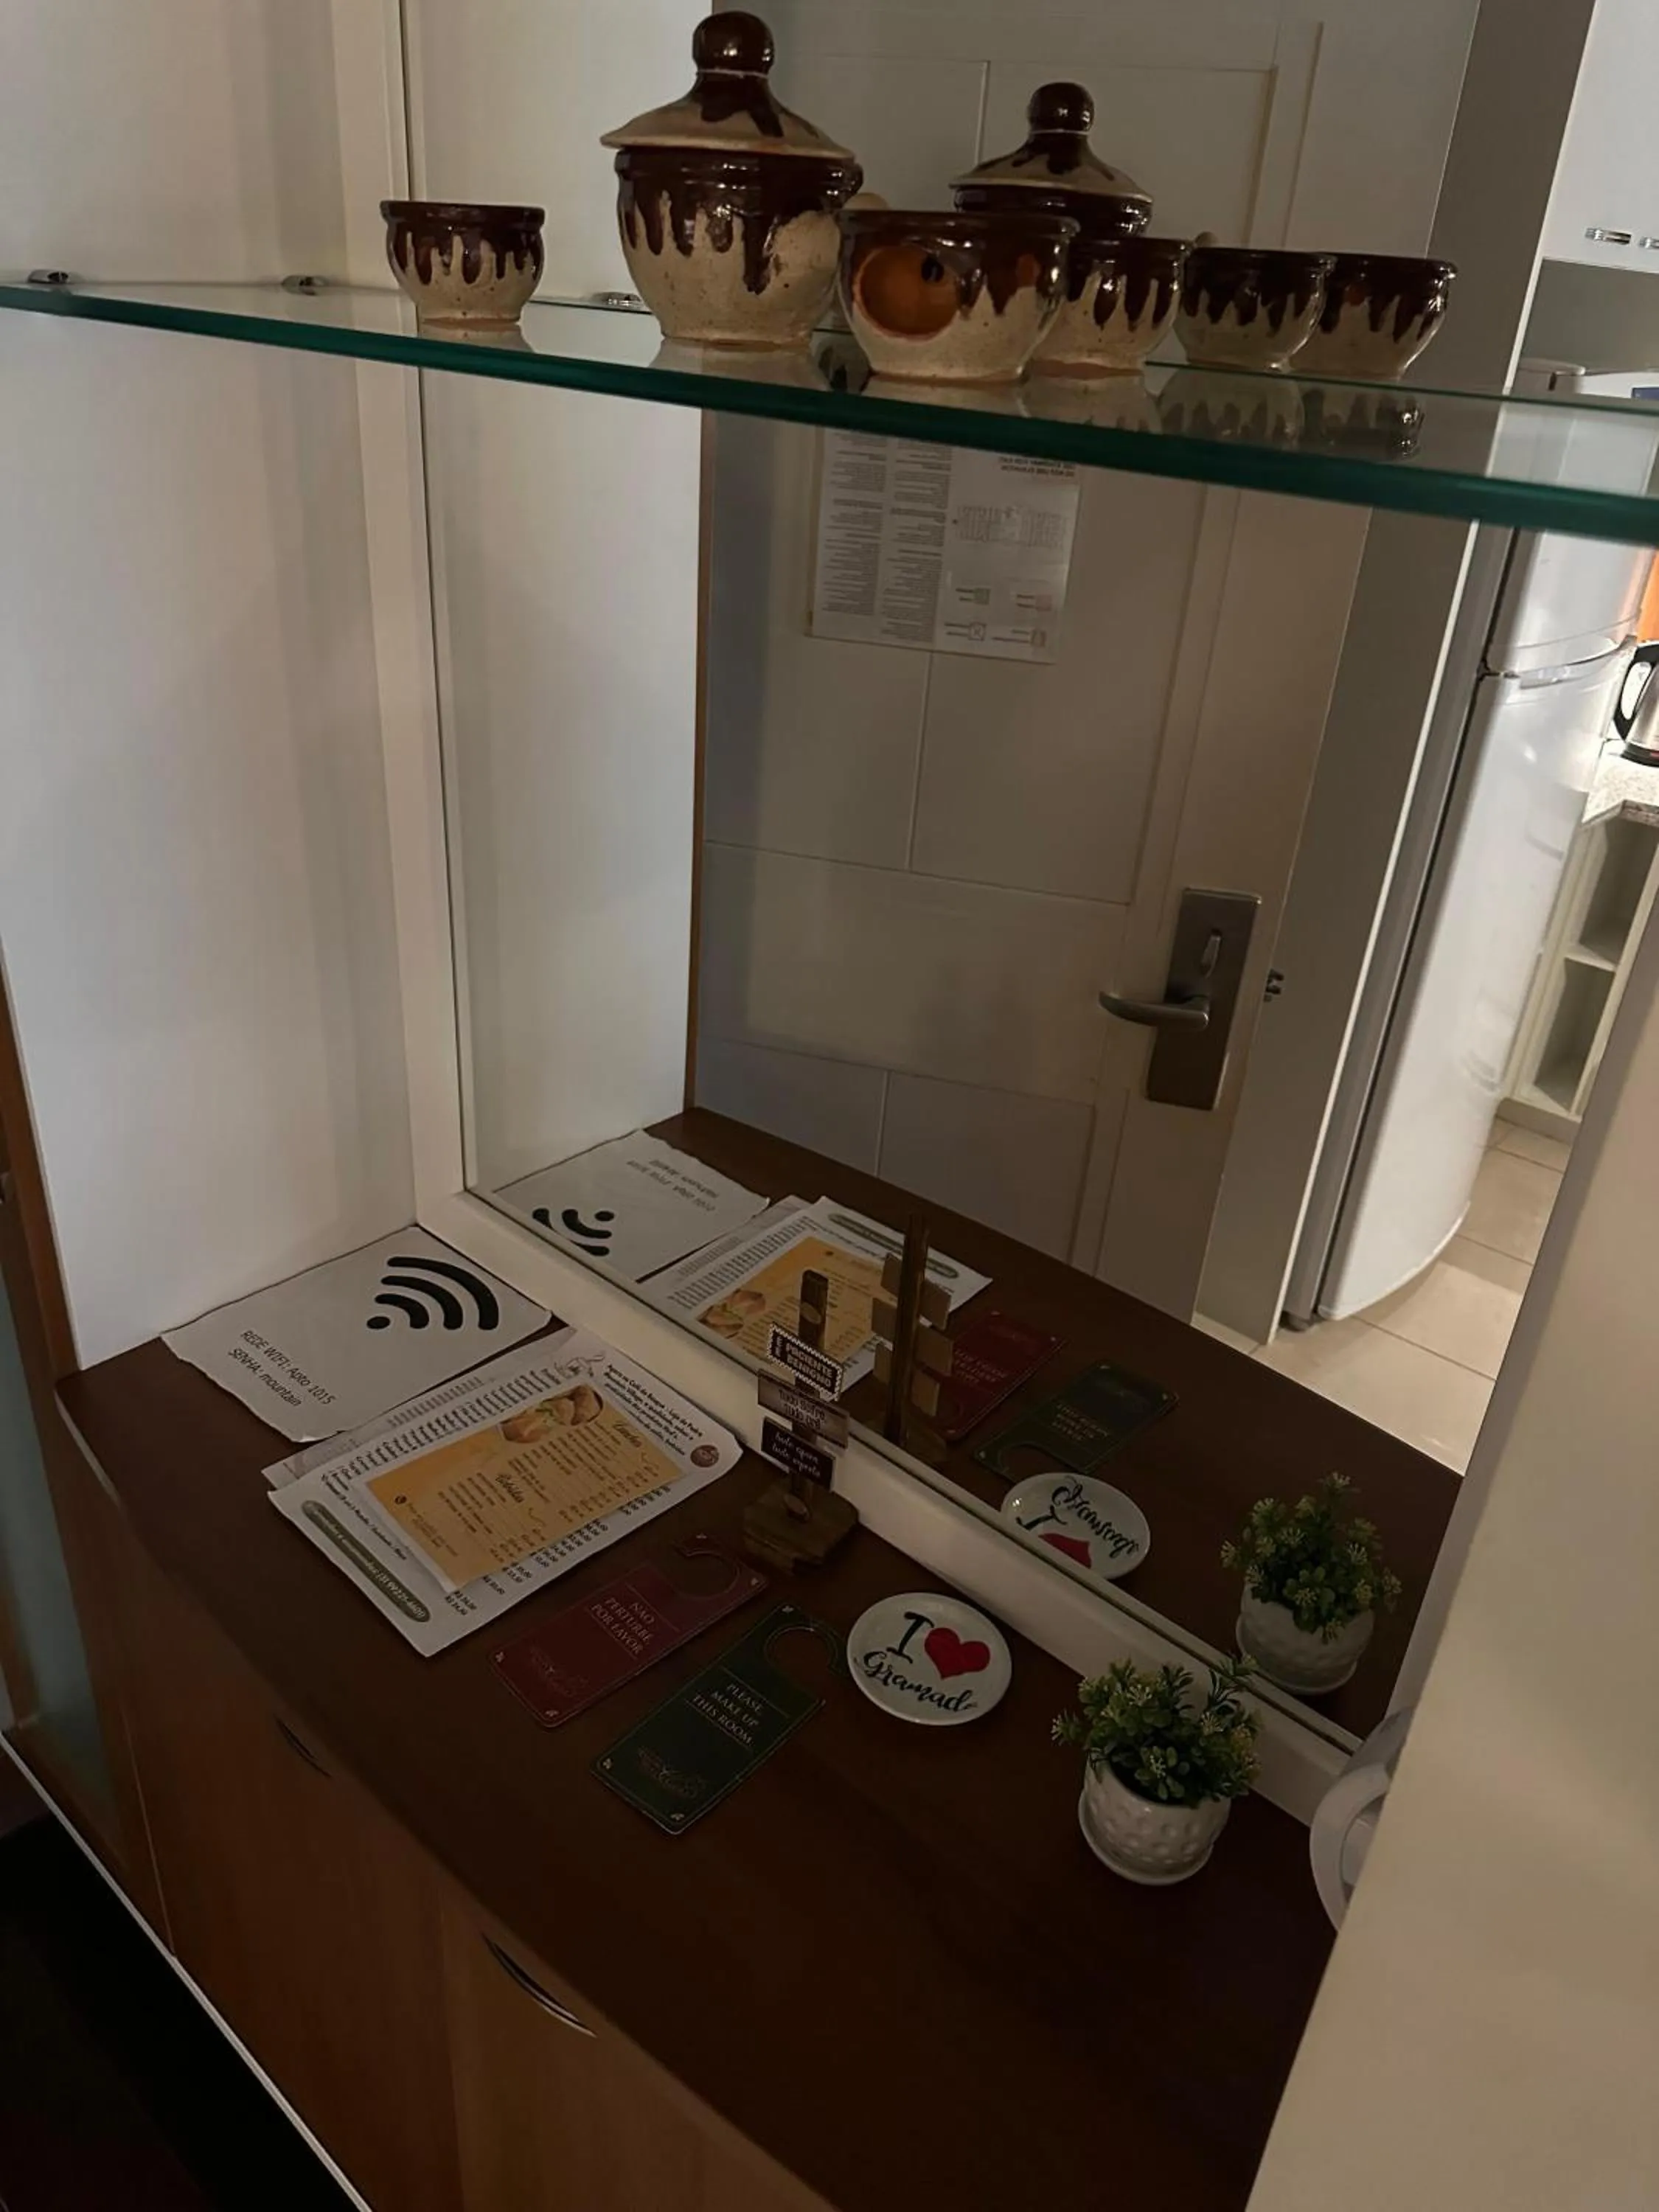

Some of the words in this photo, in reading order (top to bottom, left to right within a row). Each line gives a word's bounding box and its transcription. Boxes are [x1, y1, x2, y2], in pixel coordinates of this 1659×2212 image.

[229, 1348, 263, 1374] SENHA:
[260, 1373, 302, 1407] mountain
[241, 1330, 268, 1349] REDE
[288, 1367, 310, 1387] Apto
[308, 1385, 336, 1405] 1015
[786, 1342, 833, 1378] PACIENTE
[611, 1623, 644, 1655] FAVOR
[710, 1690, 741, 1715] MAKE
[741, 1713, 759, 1728] UP
[726, 1683, 762, 1717] PLEASE
[692, 1693, 719, 1717] THIS
[718, 1714, 756, 1747] ROOM
